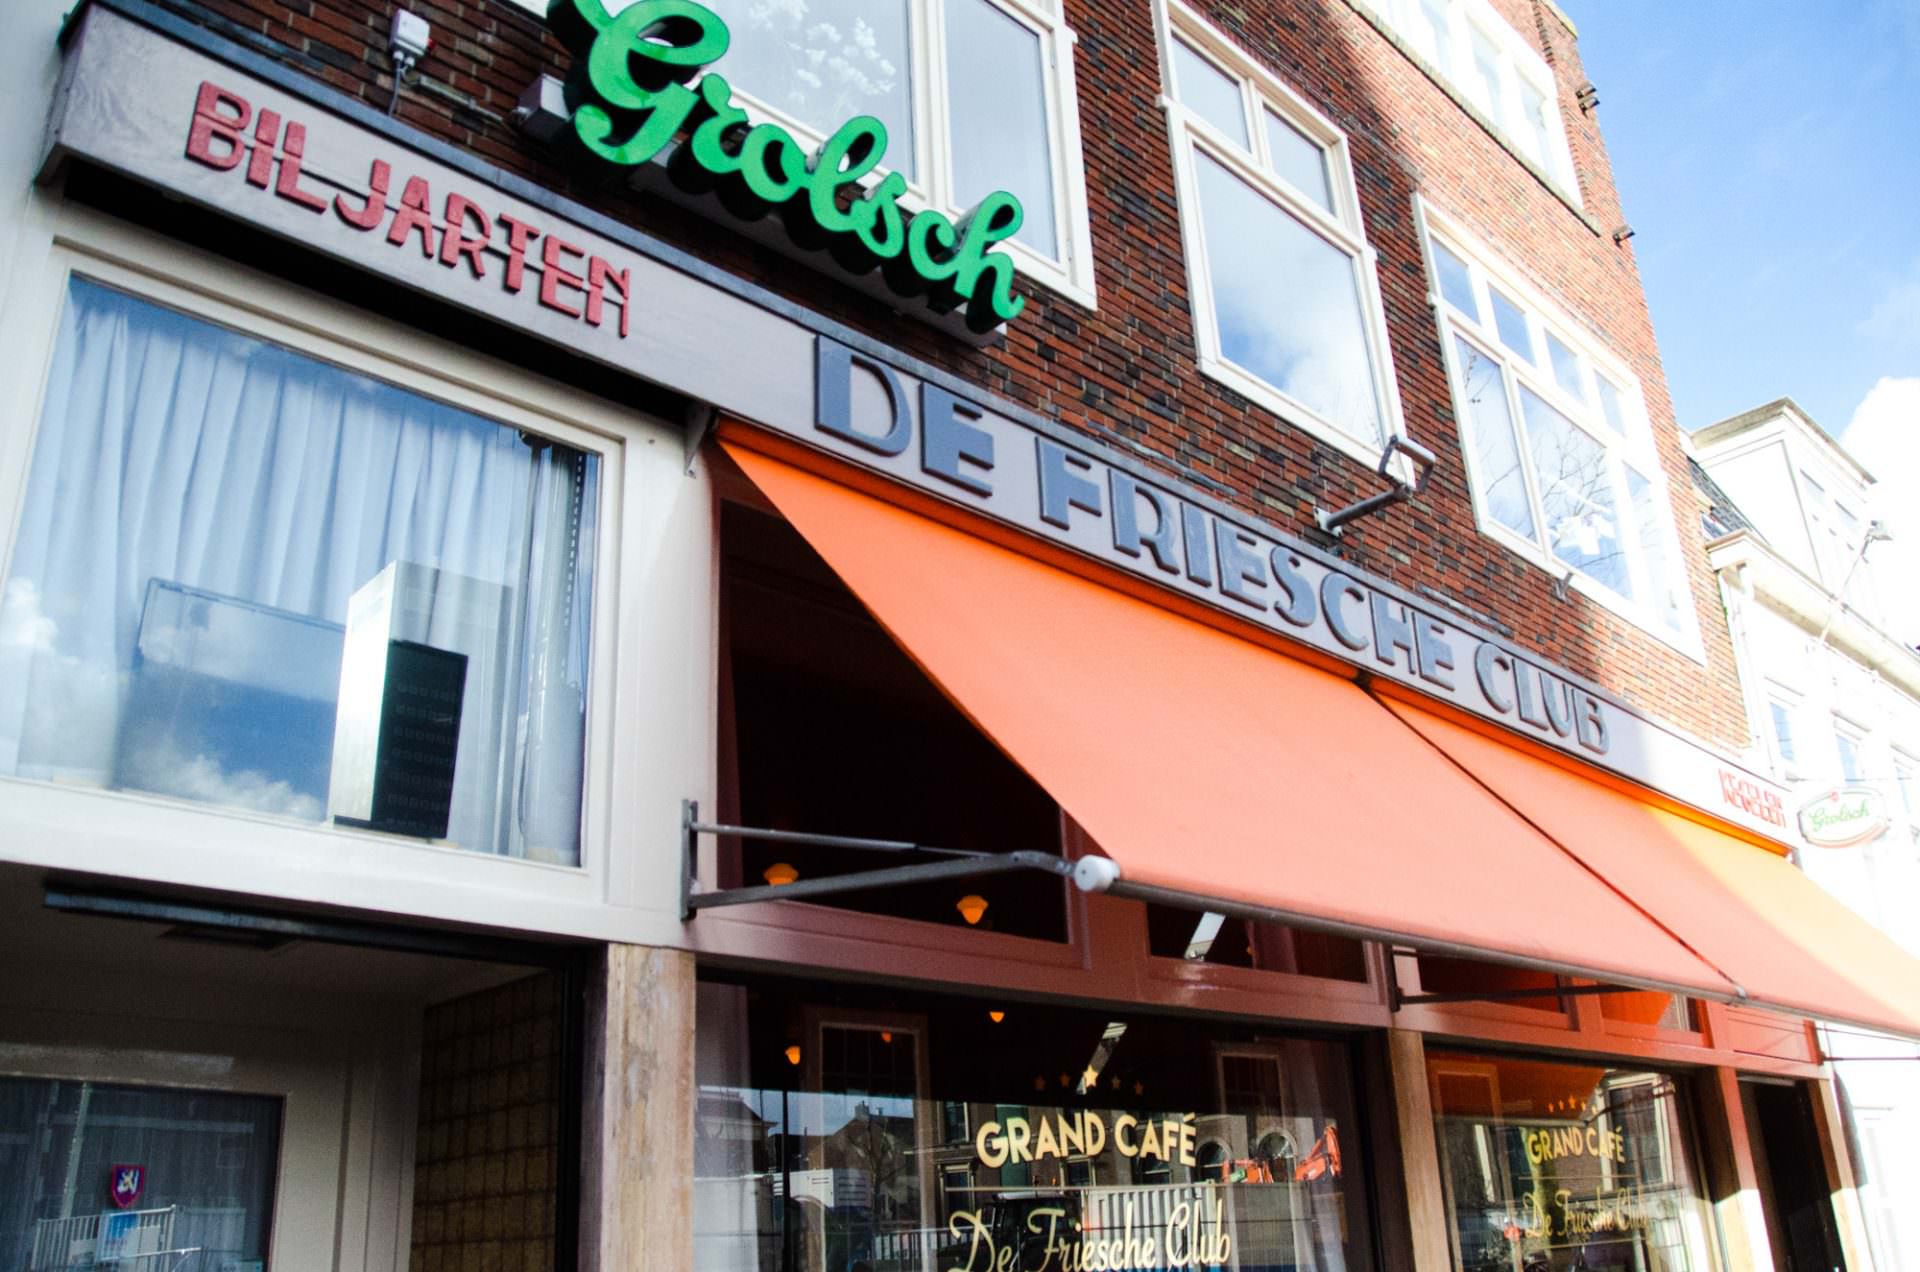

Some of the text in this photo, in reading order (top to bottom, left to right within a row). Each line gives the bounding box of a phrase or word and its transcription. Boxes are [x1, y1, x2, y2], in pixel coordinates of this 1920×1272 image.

[576, 0, 1025, 320] Grolsch
[185, 80, 630, 338] BILJARTEN
[814, 333, 1610, 756] DE FRIESCHE CLUB
[1809, 799, 1869, 832] Grolsch
[976, 1112, 1197, 1168] GRAND CAFÉ
[1527, 1126, 1626, 1165] GRAND CAFÉ
[948, 1198, 1231, 1272] De Friesche Club
[1522, 1191, 1553, 1237] De
